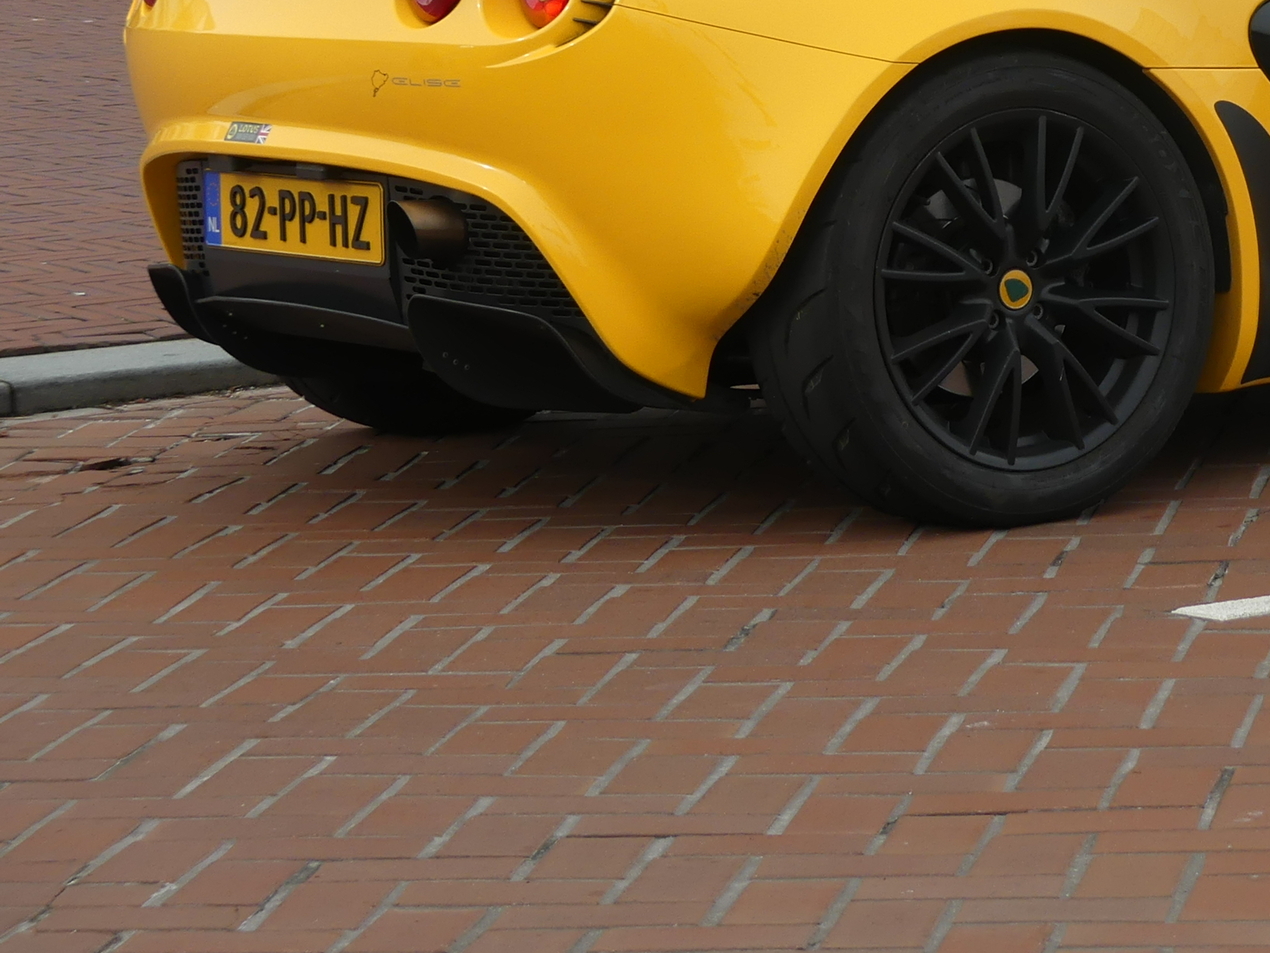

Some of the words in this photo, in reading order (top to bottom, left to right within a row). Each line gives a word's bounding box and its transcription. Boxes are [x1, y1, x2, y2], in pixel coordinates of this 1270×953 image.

[391, 77, 461, 87] ELISE
[238, 124, 260, 134] LOTUS
[229, 184, 371, 251] 82-PP-HZ
[207, 216, 220, 233] NL
